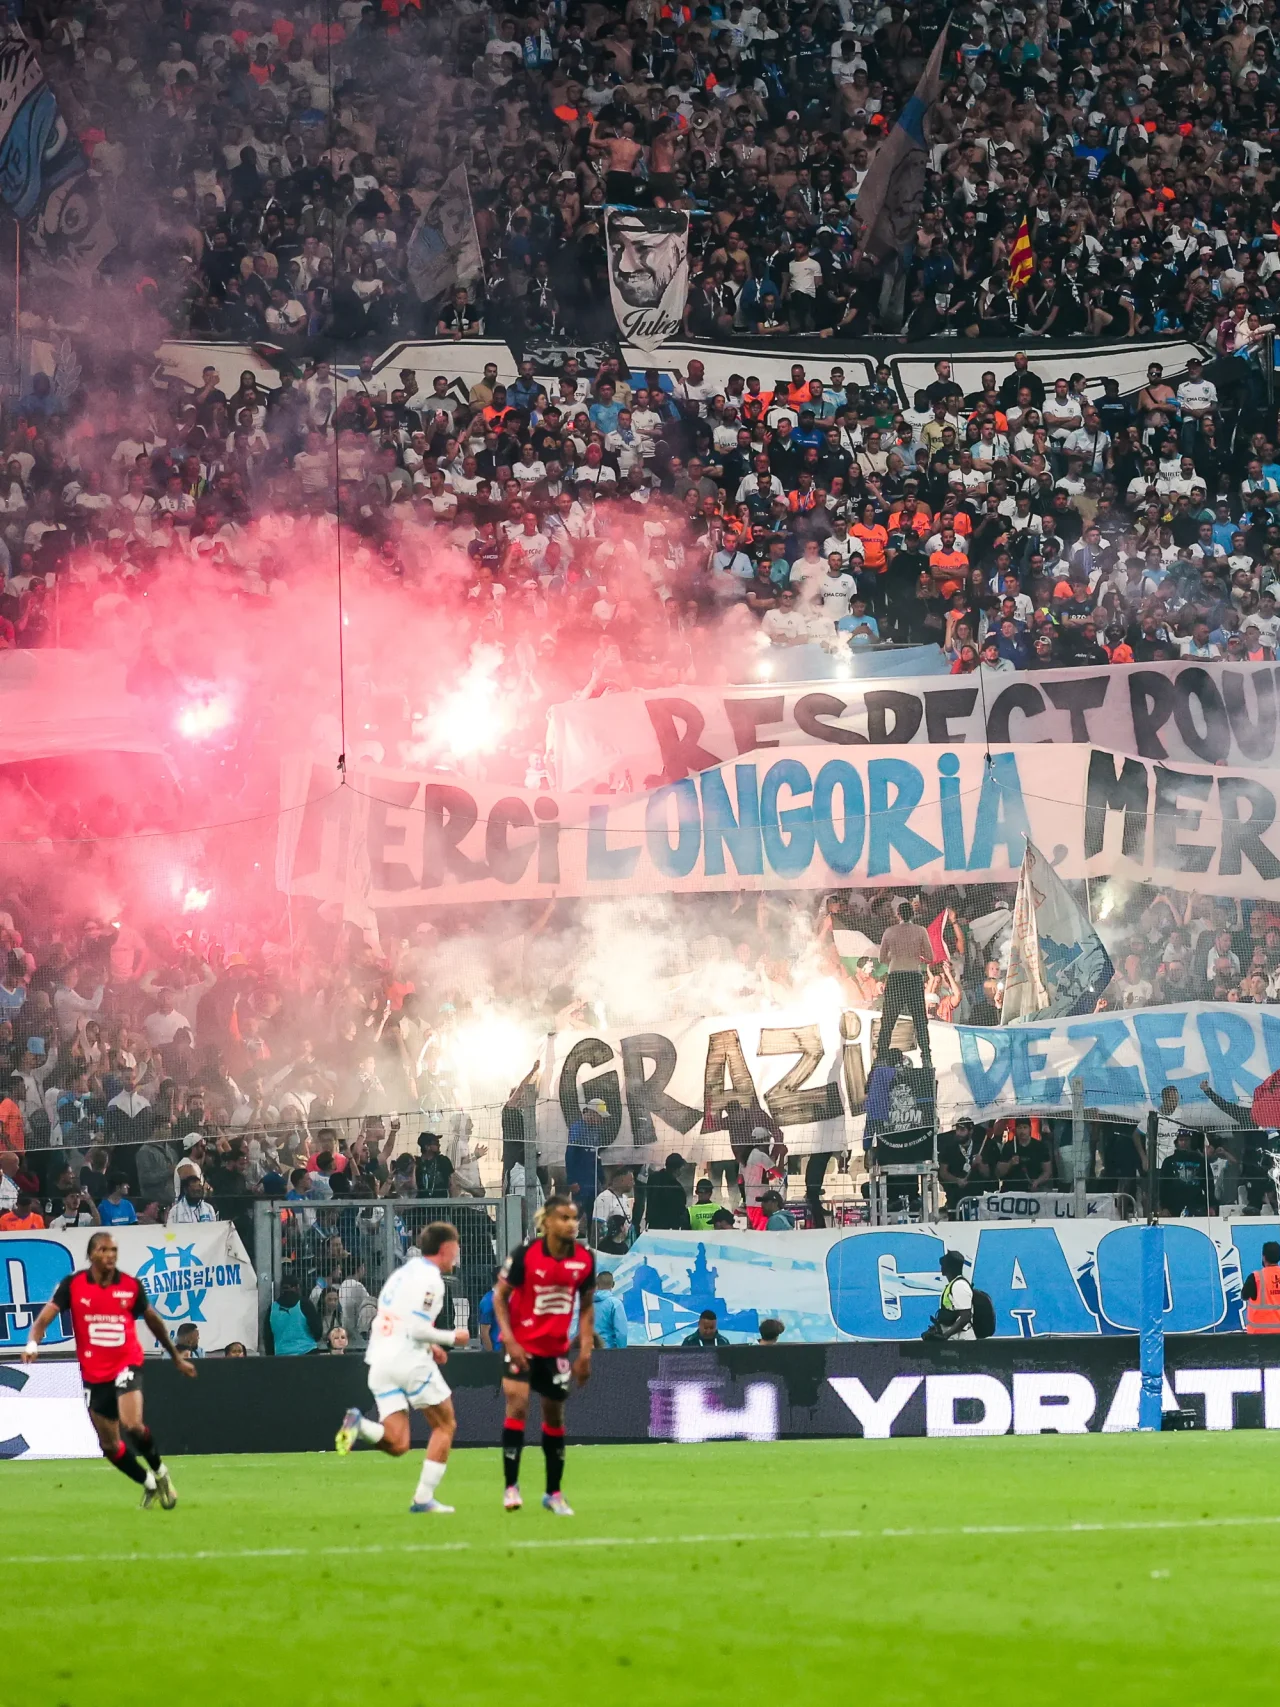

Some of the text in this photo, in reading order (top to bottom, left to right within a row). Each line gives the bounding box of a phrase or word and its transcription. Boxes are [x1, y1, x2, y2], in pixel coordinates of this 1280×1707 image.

[644, 674, 1110, 783] RESPECT
[987, 1195, 1098, 1219] GOOD LUK
[154, 1269, 192, 1293] AMIS
[193, 1270, 203, 1287] DE
[204, 1263, 242, 1288] L'OM
